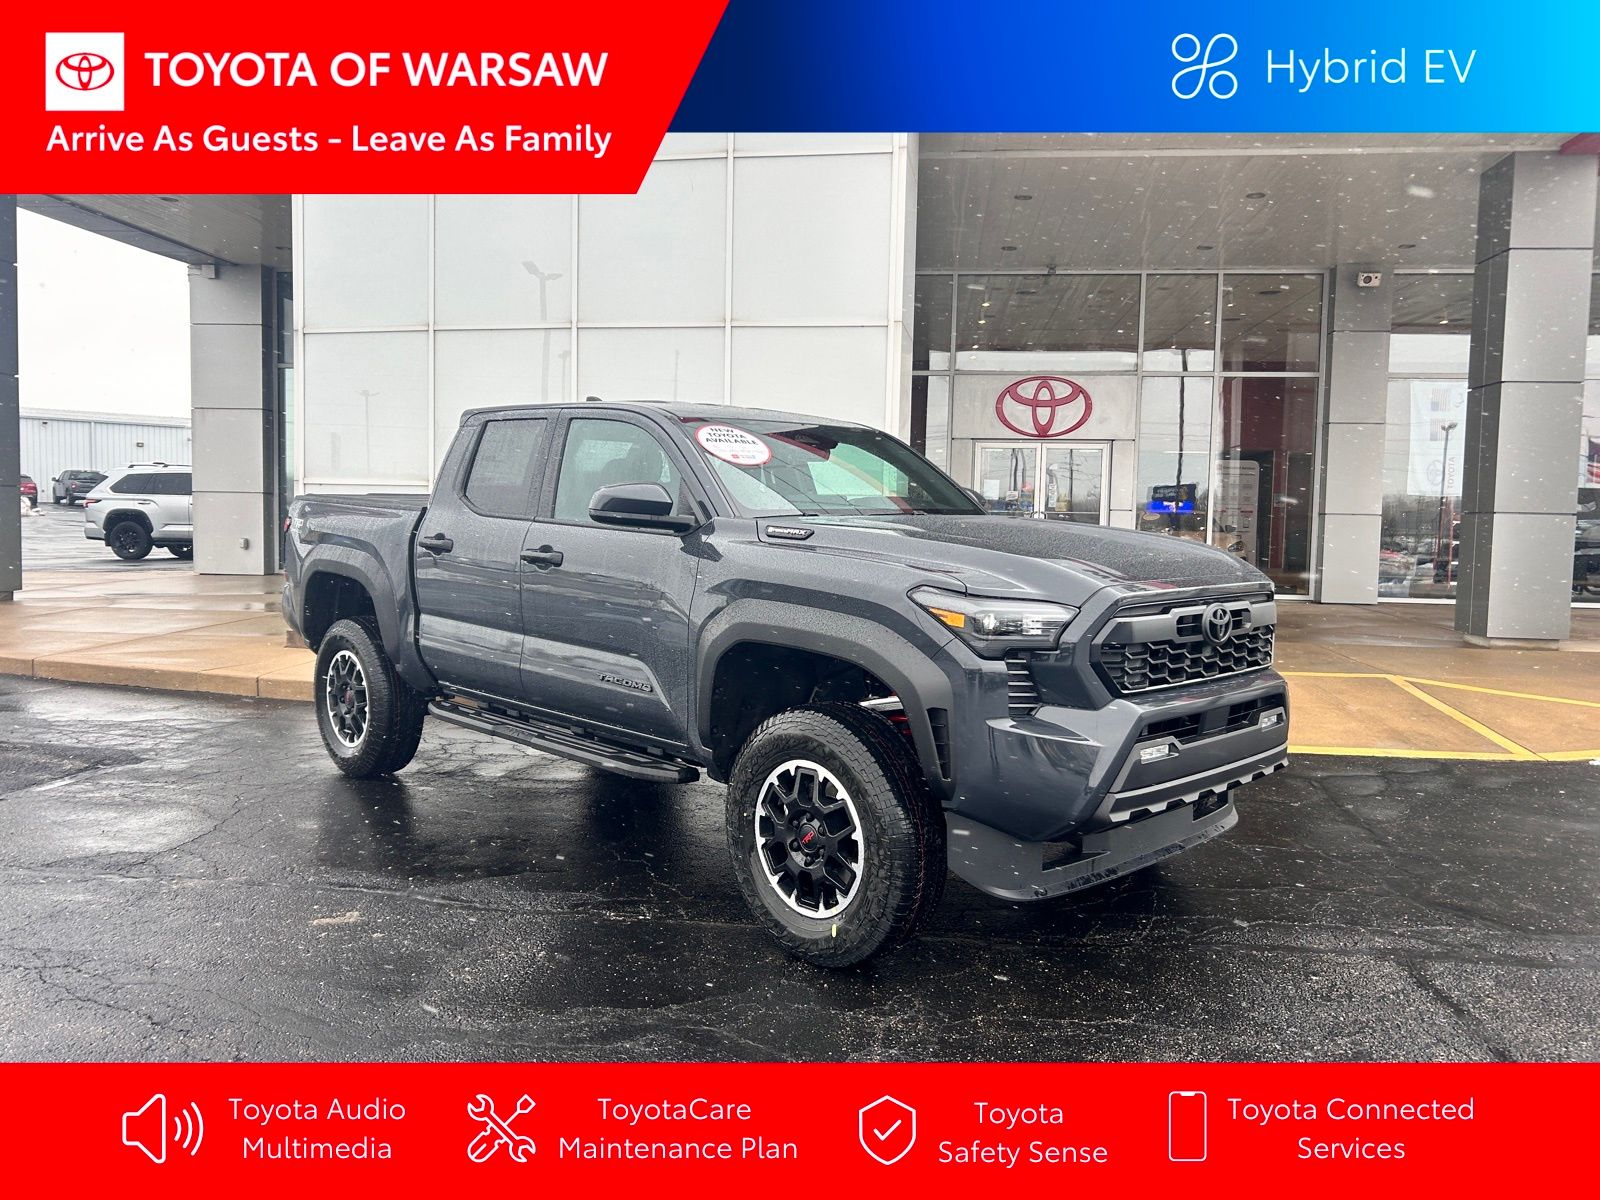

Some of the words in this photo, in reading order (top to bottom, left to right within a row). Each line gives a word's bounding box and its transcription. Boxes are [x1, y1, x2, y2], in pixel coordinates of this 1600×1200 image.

[705, 437, 759, 446] AVAILABLE
[1446, 456, 1456, 489] TOYOTA
[596, 672, 653, 692] TACOMA
